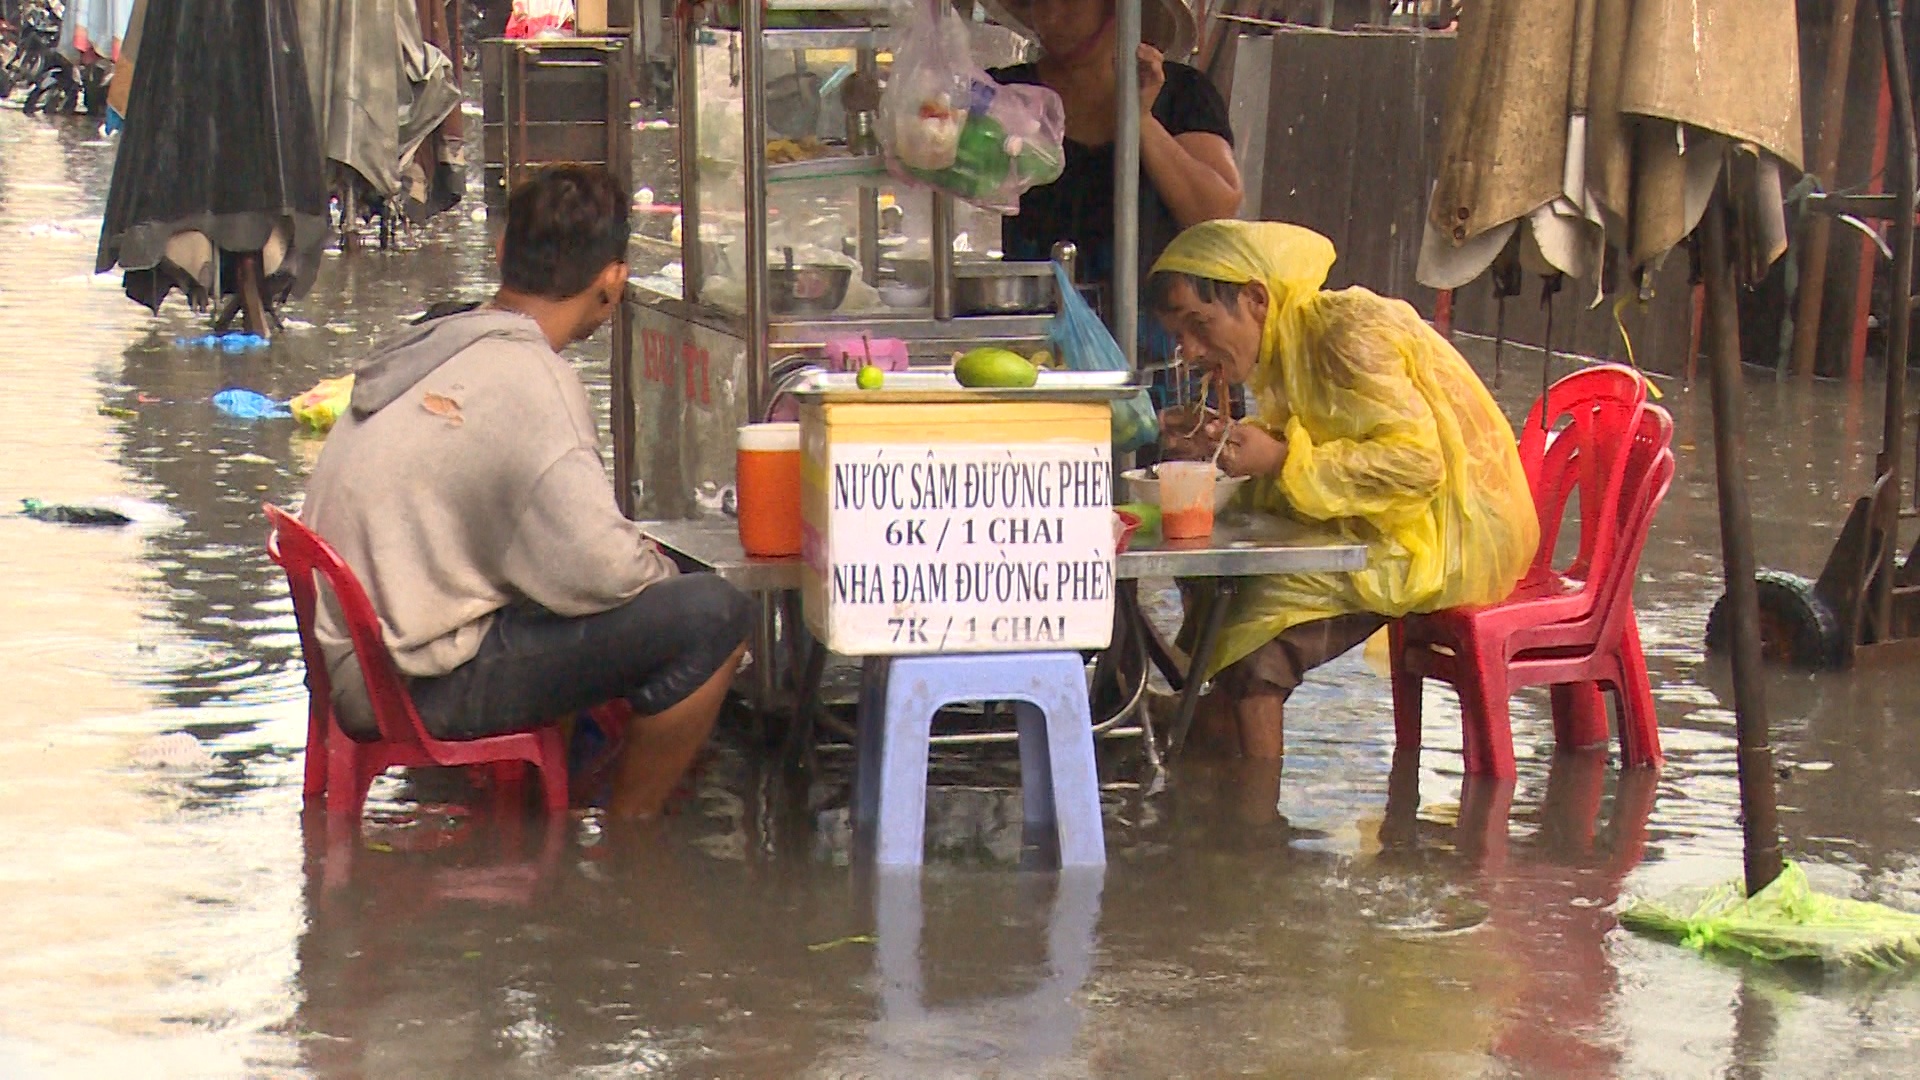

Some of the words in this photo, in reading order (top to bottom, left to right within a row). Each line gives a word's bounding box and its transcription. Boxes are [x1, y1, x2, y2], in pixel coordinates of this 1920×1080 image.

[834, 449, 904, 510] NƯỚC
[911, 449, 957, 510] SÂM
[964, 450, 1052, 509] ĐƯỜNG
[885, 518, 927, 546] 6K
[962, 518, 977, 545] 1
[988, 517, 1064, 545] CHAI
[832, 563, 885, 604] NHA
[892, 562, 948, 603] ĐAM
[955, 550, 1049, 602] ĐƯỜNG
[887, 618, 928, 643] 7K
[964, 618, 977, 643] 1
[991, 616, 1066, 643] CHAI
